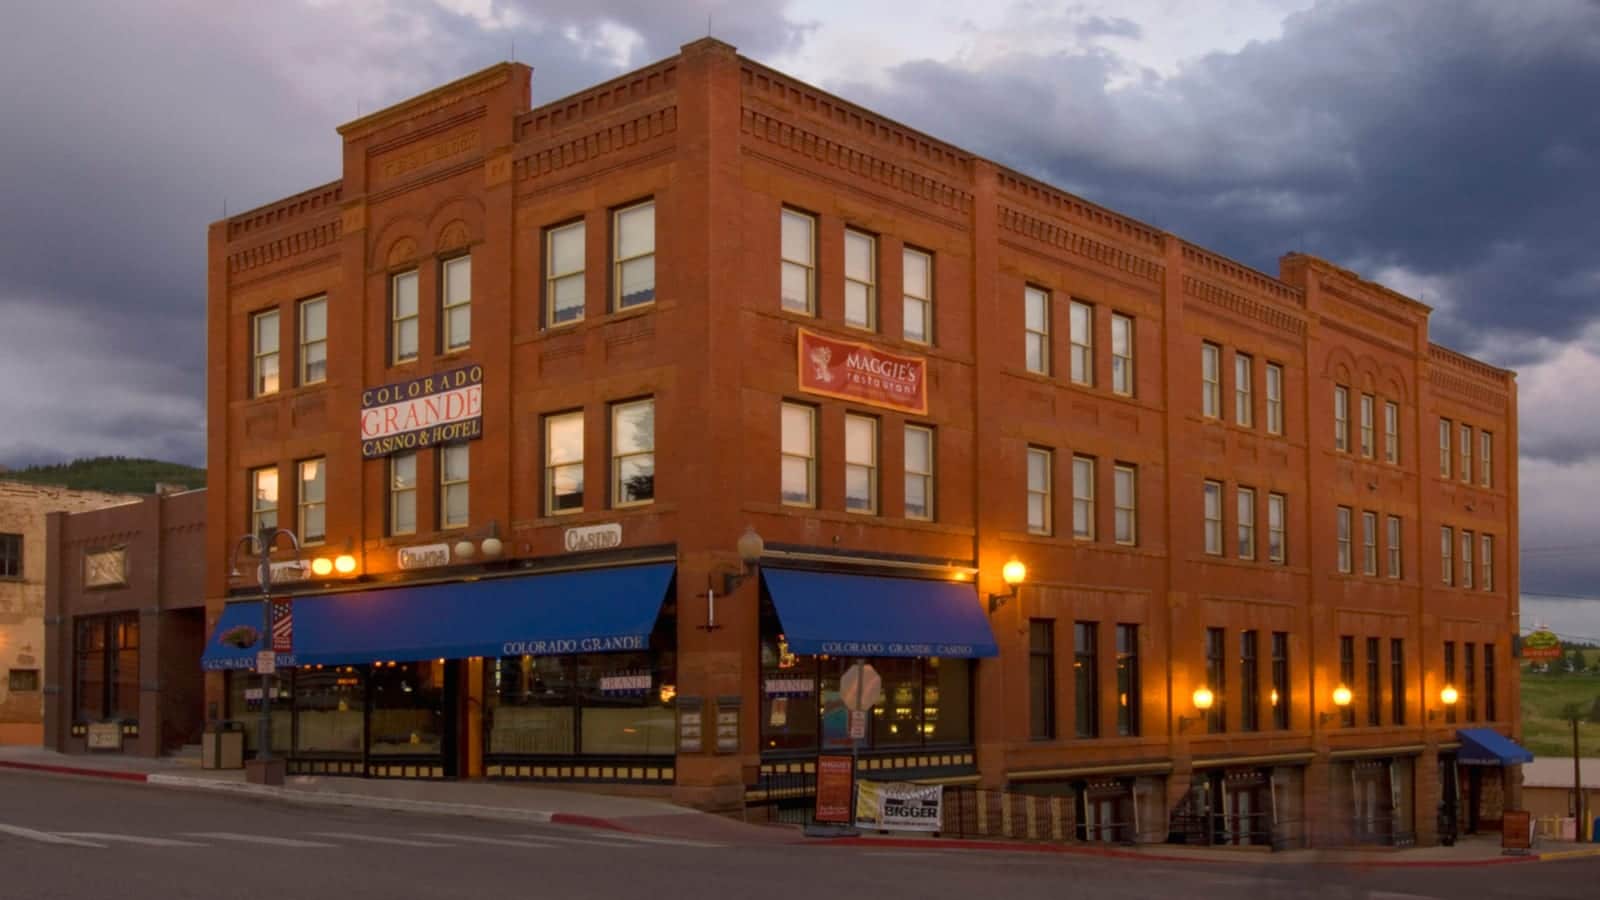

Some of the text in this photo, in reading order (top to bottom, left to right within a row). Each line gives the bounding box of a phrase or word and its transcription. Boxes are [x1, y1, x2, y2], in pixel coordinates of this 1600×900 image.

[846, 352, 916, 382] MAGGIE'S
[363, 366, 482, 406] COLORADO
[848, 372, 916, 393] restaurant
[361, 386, 481, 437] GRANDE
[363, 421, 480, 456] CASINO & HOTEL
[503, 635, 642, 655] COLORADO GRANDE
[822, 642, 973, 654] COLORADO GRANDE CASINO
[884, 805, 937, 819] BIGGER
